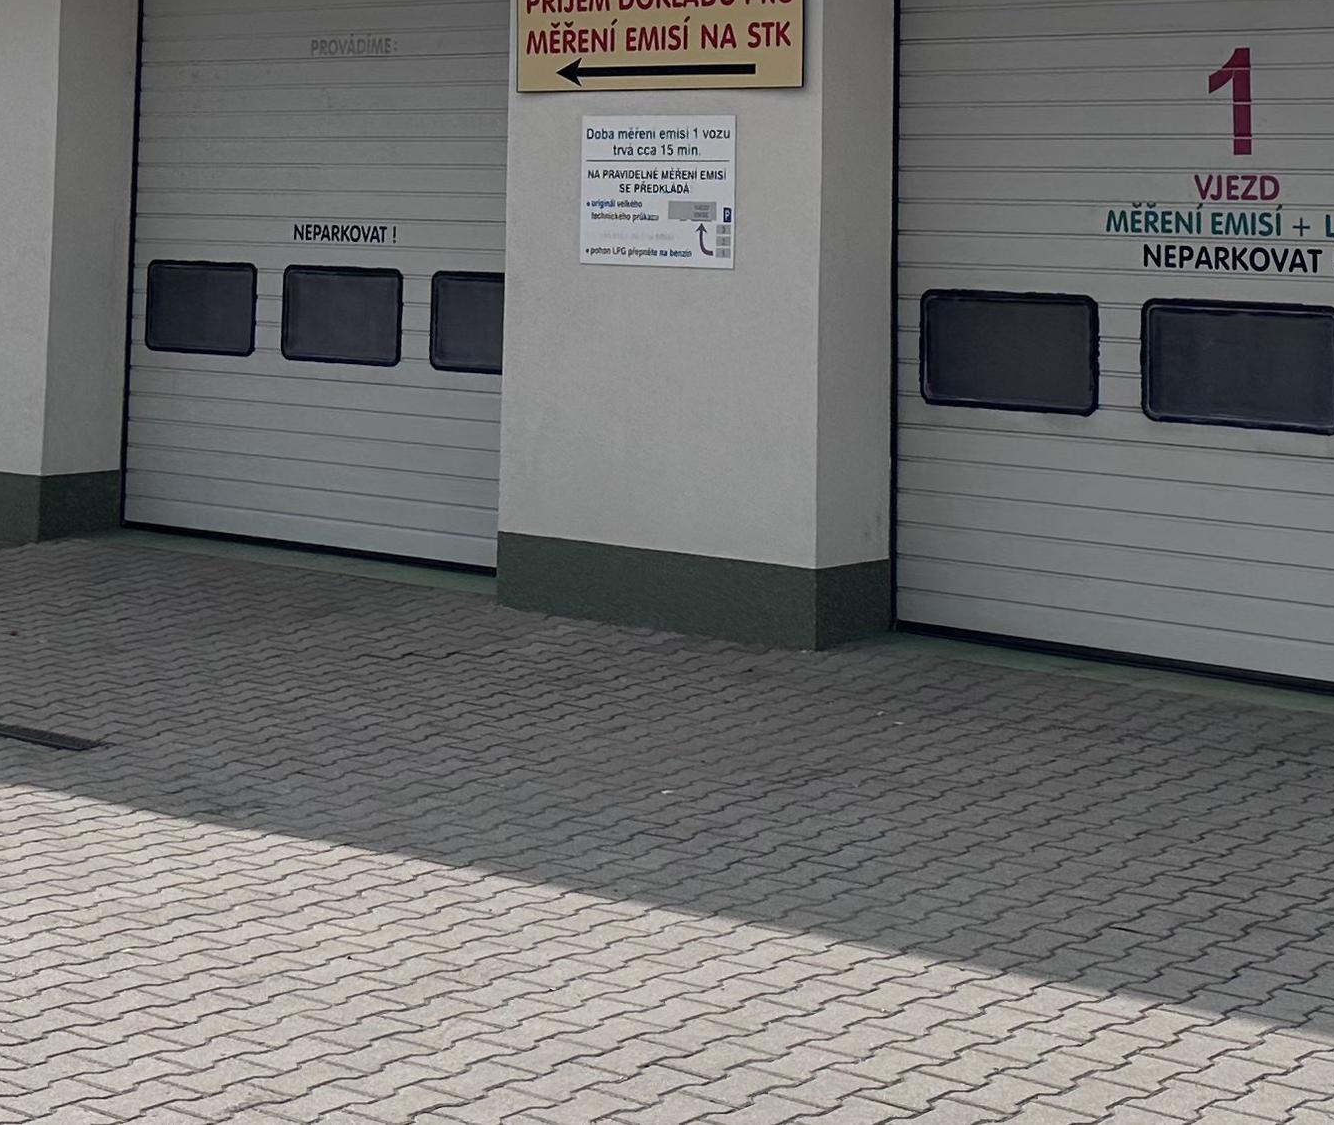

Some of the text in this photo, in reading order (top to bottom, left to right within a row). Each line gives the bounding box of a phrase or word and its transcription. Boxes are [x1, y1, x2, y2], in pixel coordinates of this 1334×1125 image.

[525, 16, 792, 55] MĚŘENÍ EMISÍ NA STK
[1208, 47, 1253, 155] 1
[586, 127, 615, 140] Doba
[693, 127, 699, 139] 1
[702, 129, 731, 140] vozu
[613, 144, 634, 156] trvá
[636, 146, 657, 156] cca
[660, 144, 674, 156] 15
[587, 169, 601, 179] NA
[602, 167, 659, 180] PRAVIDELNÉ
[660, 166, 698, 180] MĚŘENÍ
[618, 183, 632, 194] SE
[1193, 174, 1281, 201] VJEZD
[1105, 202, 1204, 234] MĚŘENÍ
[1210, 203, 1283, 237] EMISÍ
[1292, 217, 1311, 237] +
[293, 223, 397, 244] NEPARKOVAT !
[1142, 243, 1323, 274] NEPARKOVAT
